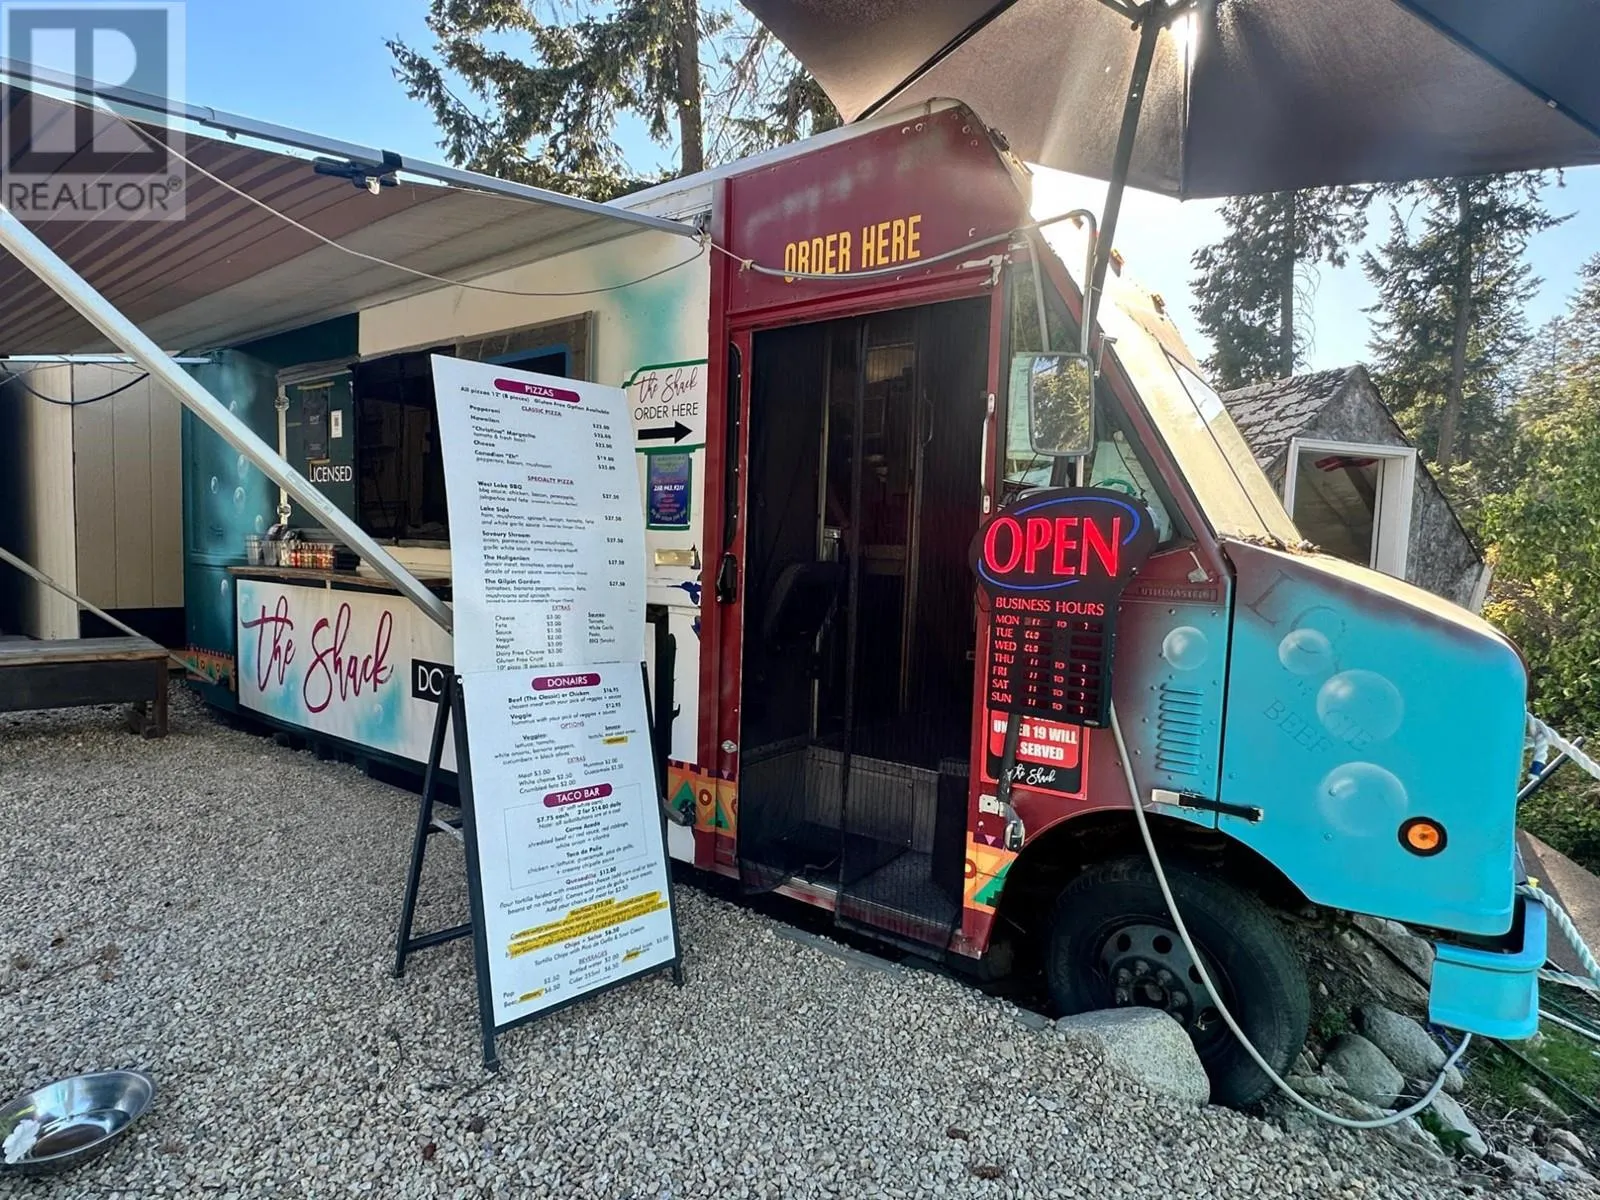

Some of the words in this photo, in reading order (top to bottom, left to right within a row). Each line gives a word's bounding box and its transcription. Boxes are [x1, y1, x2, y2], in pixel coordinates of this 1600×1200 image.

[785, 231, 851, 283] ORDER
[861, 214, 922, 268] HERE
[525, 385, 554, 397] PIZZAS
[661, 367, 697, 403] Shack
[634, 405, 669, 420] ORDER
[672, 402, 698, 417] HERE
[310, 464, 352, 482] LICENSED
[984, 517, 1121, 577] OPEN
[995, 597, 1051, 612] BUSINESS
[1055, 601, 1105, 616] HOURS
[995, 614, 1020, 625] MON
[1056, 620, 1068, 628] TO
[996, 627, 1014, 638] TUE
[995, 640, 1017, 651] WED
[303, 602, 394, 713] Shack
[995, 652, 1014, 664] THU
[1055, 661, 1065, 669] TO
[547, 676, 588, 687] DONAIRS
[993, 666, 1007, 676] FRI
[1053, 675, 1064, 683] TO
[992, 679, 1009, 689] SAT
[1052, 689, 1063, 697] TO
[991, 692, 1012, 704] SUN
[1052, 703, 1062, 711] TO
[993, 719, 1031, 737] UNER
[1033, 726, 1047, 739] 19
[1049, 728, 1077, 744] WILL
[1020, 741, 1064, 760] SERVED
[556, 792, 582, 803] TACO
[584, 787, 600, 798] BAR
